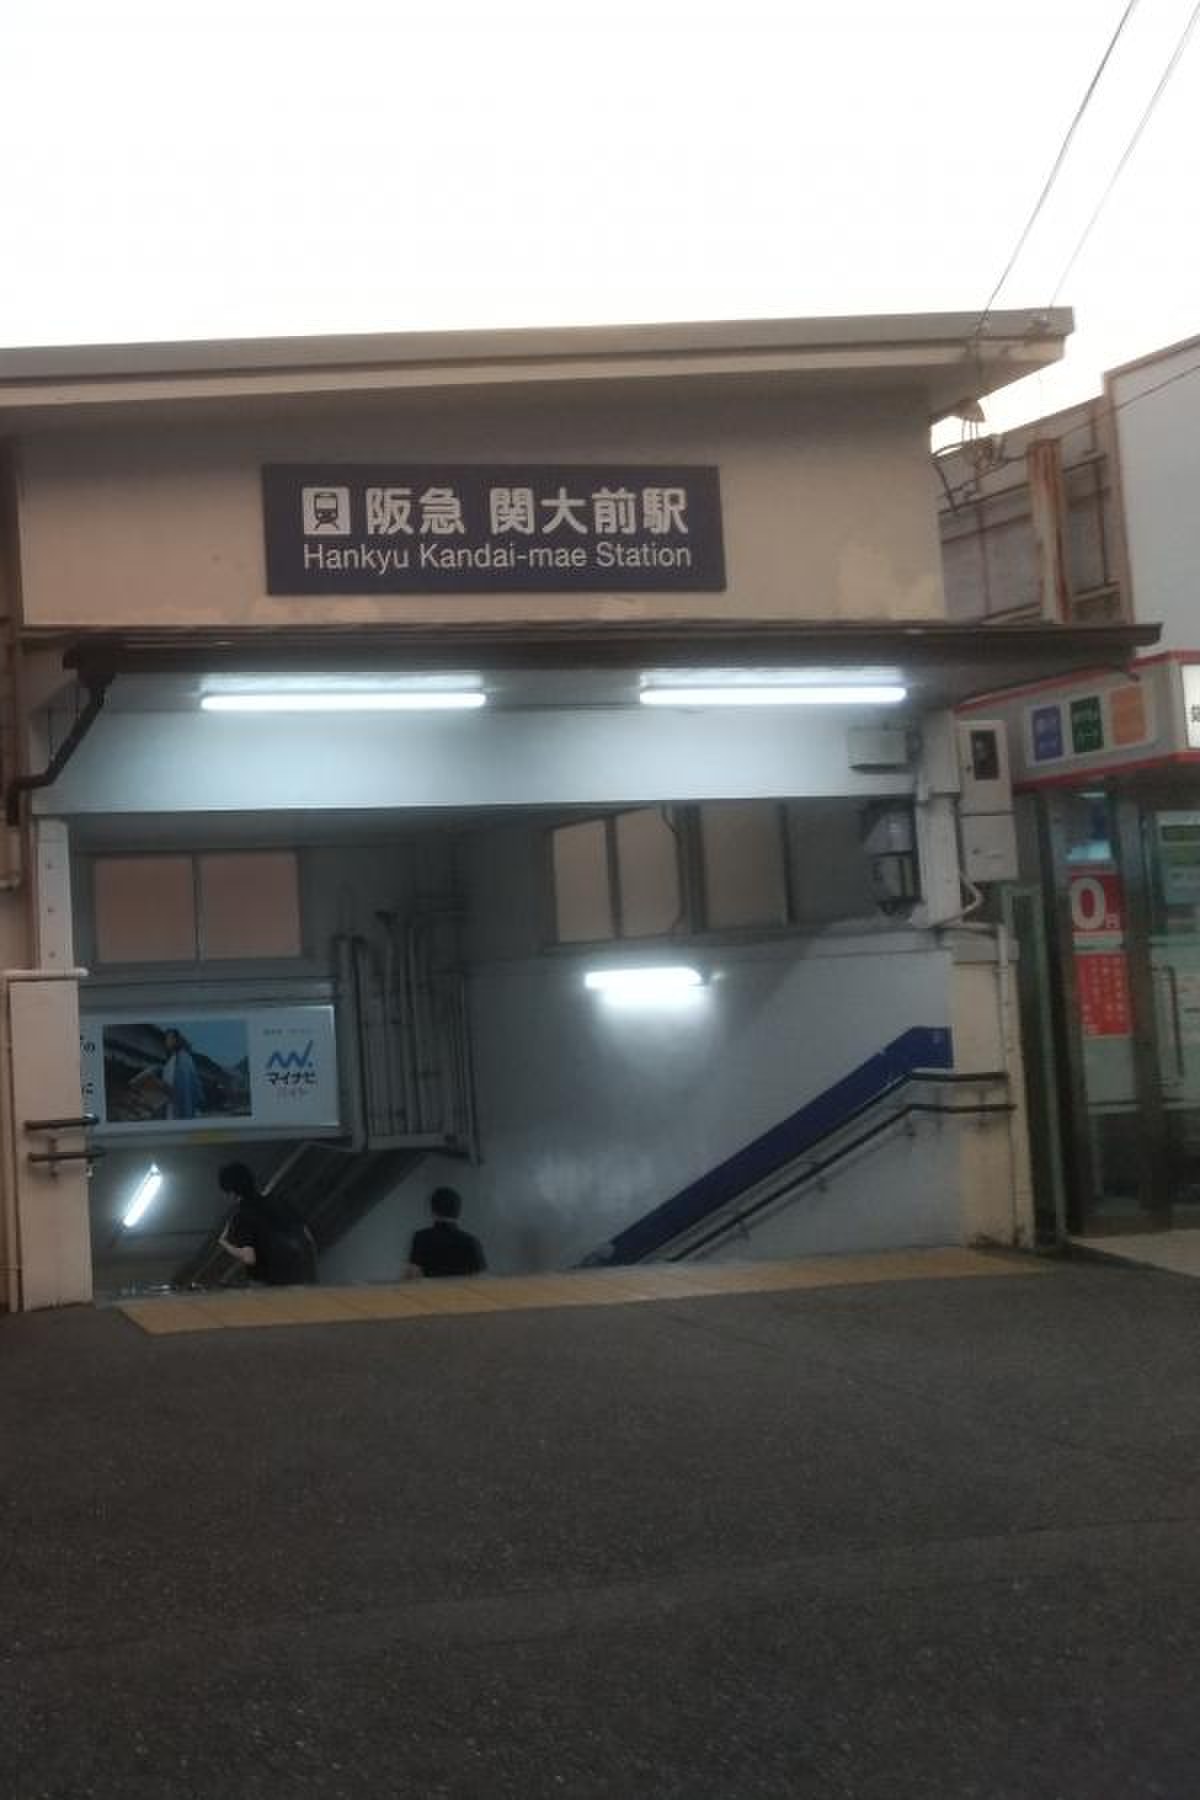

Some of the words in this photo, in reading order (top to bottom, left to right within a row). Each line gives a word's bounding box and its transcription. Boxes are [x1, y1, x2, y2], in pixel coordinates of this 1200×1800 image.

[366, 487, 465, 535] 阪急
[489, 487, 689, 535] 関大前駅
[304, 543, 409, 575] Hankyu
[420, 542, 587, 569] Kandai-mae
[596, 541, 692, 567] Station
[264, 1071, 317, 1085] マイナビ
